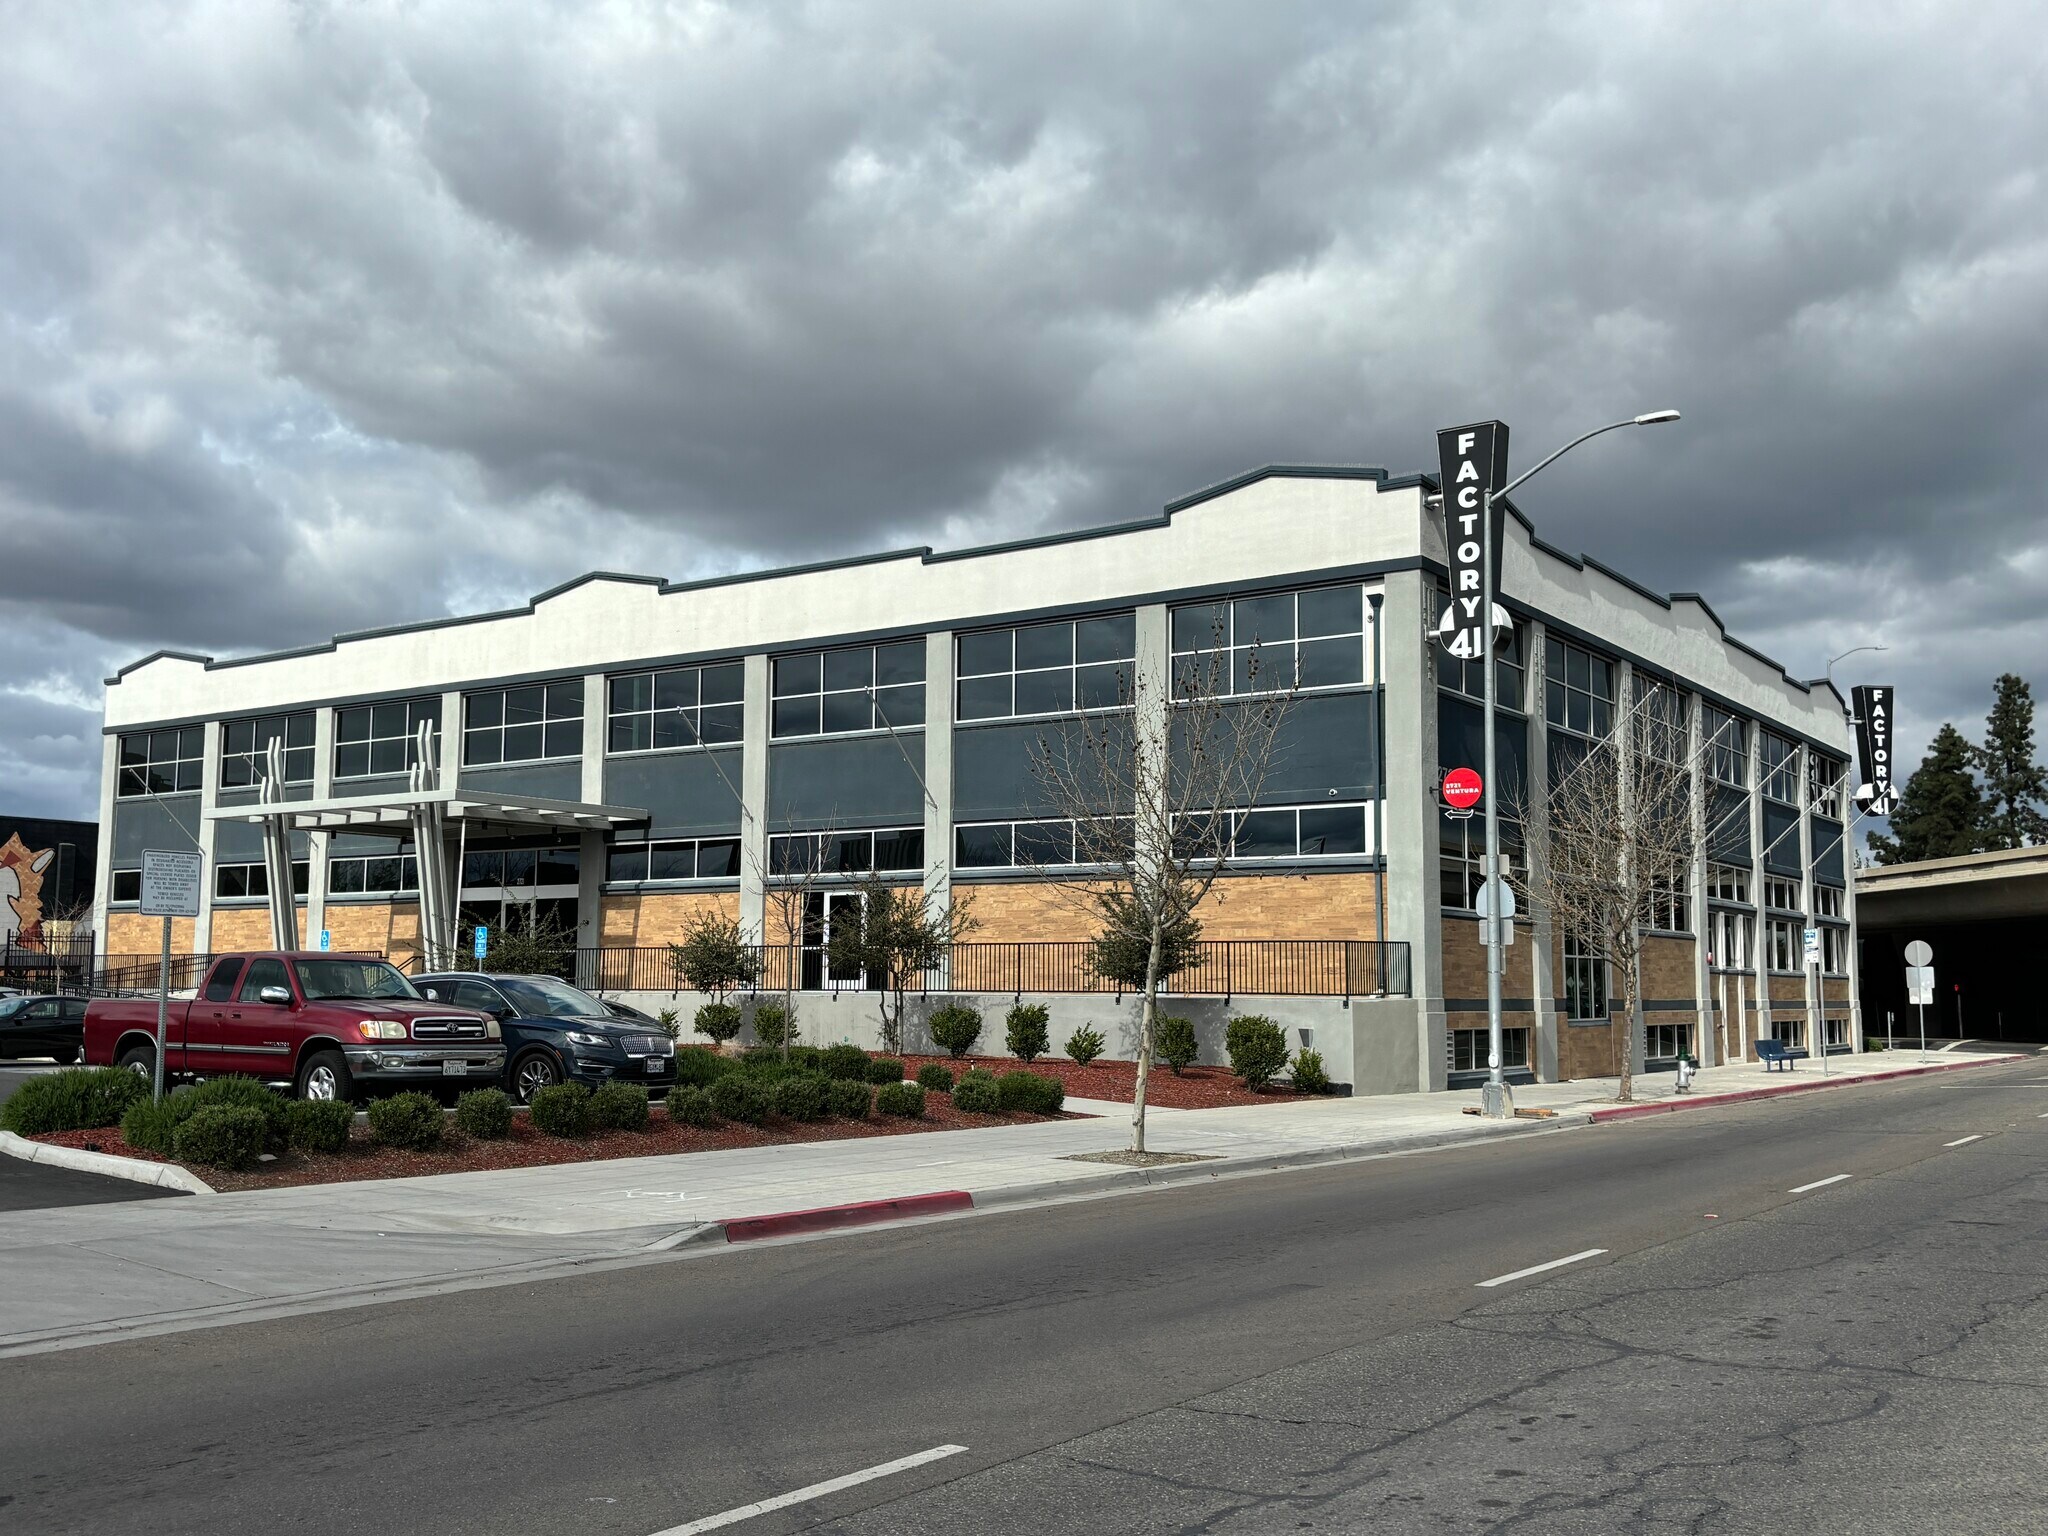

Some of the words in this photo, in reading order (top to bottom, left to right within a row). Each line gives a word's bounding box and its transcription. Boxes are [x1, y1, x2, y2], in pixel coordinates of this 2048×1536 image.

[1455, 432, 1482, 619] FACTORY
[1448, 627, 1482, 659] 41
[1872, 689, 1888, 793] FACTORY
[1871, 797, 1889, 815] 41
